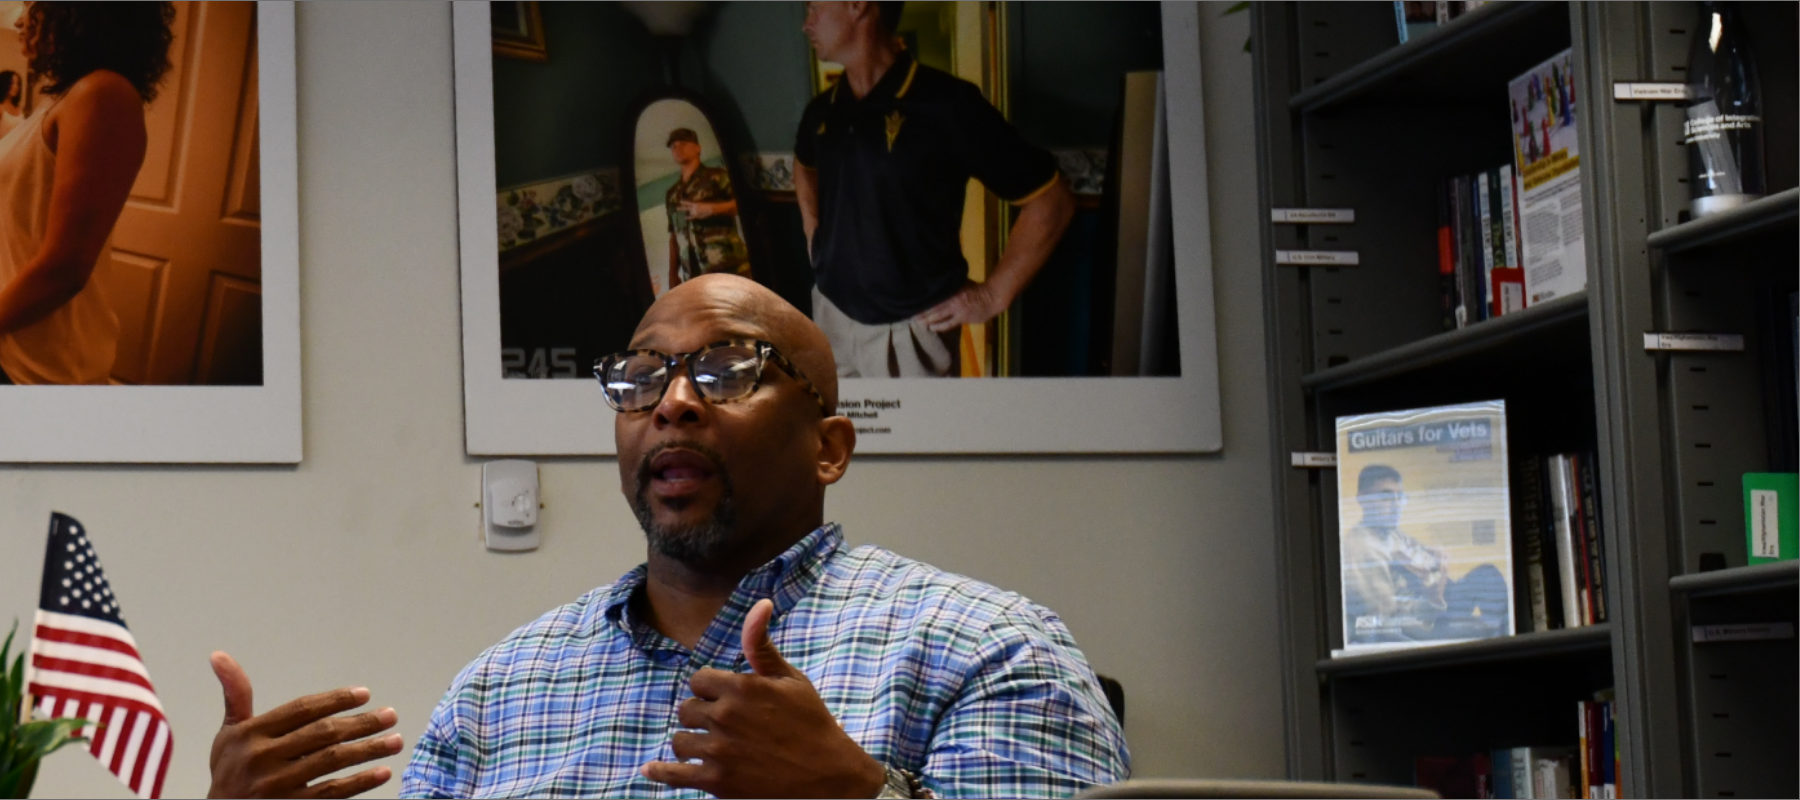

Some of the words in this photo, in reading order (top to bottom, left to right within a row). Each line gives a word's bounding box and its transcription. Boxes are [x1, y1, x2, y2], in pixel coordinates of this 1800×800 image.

[1736, 121, 1752, 129] Arts
[502, 347, 577, 378] 245
[864, 399, 901, 410] Project
[1351, 429, 1414, 449] Guitars
[1419, 425, 1443, 442] for
[1448, 420, 1487, 438] Vets
